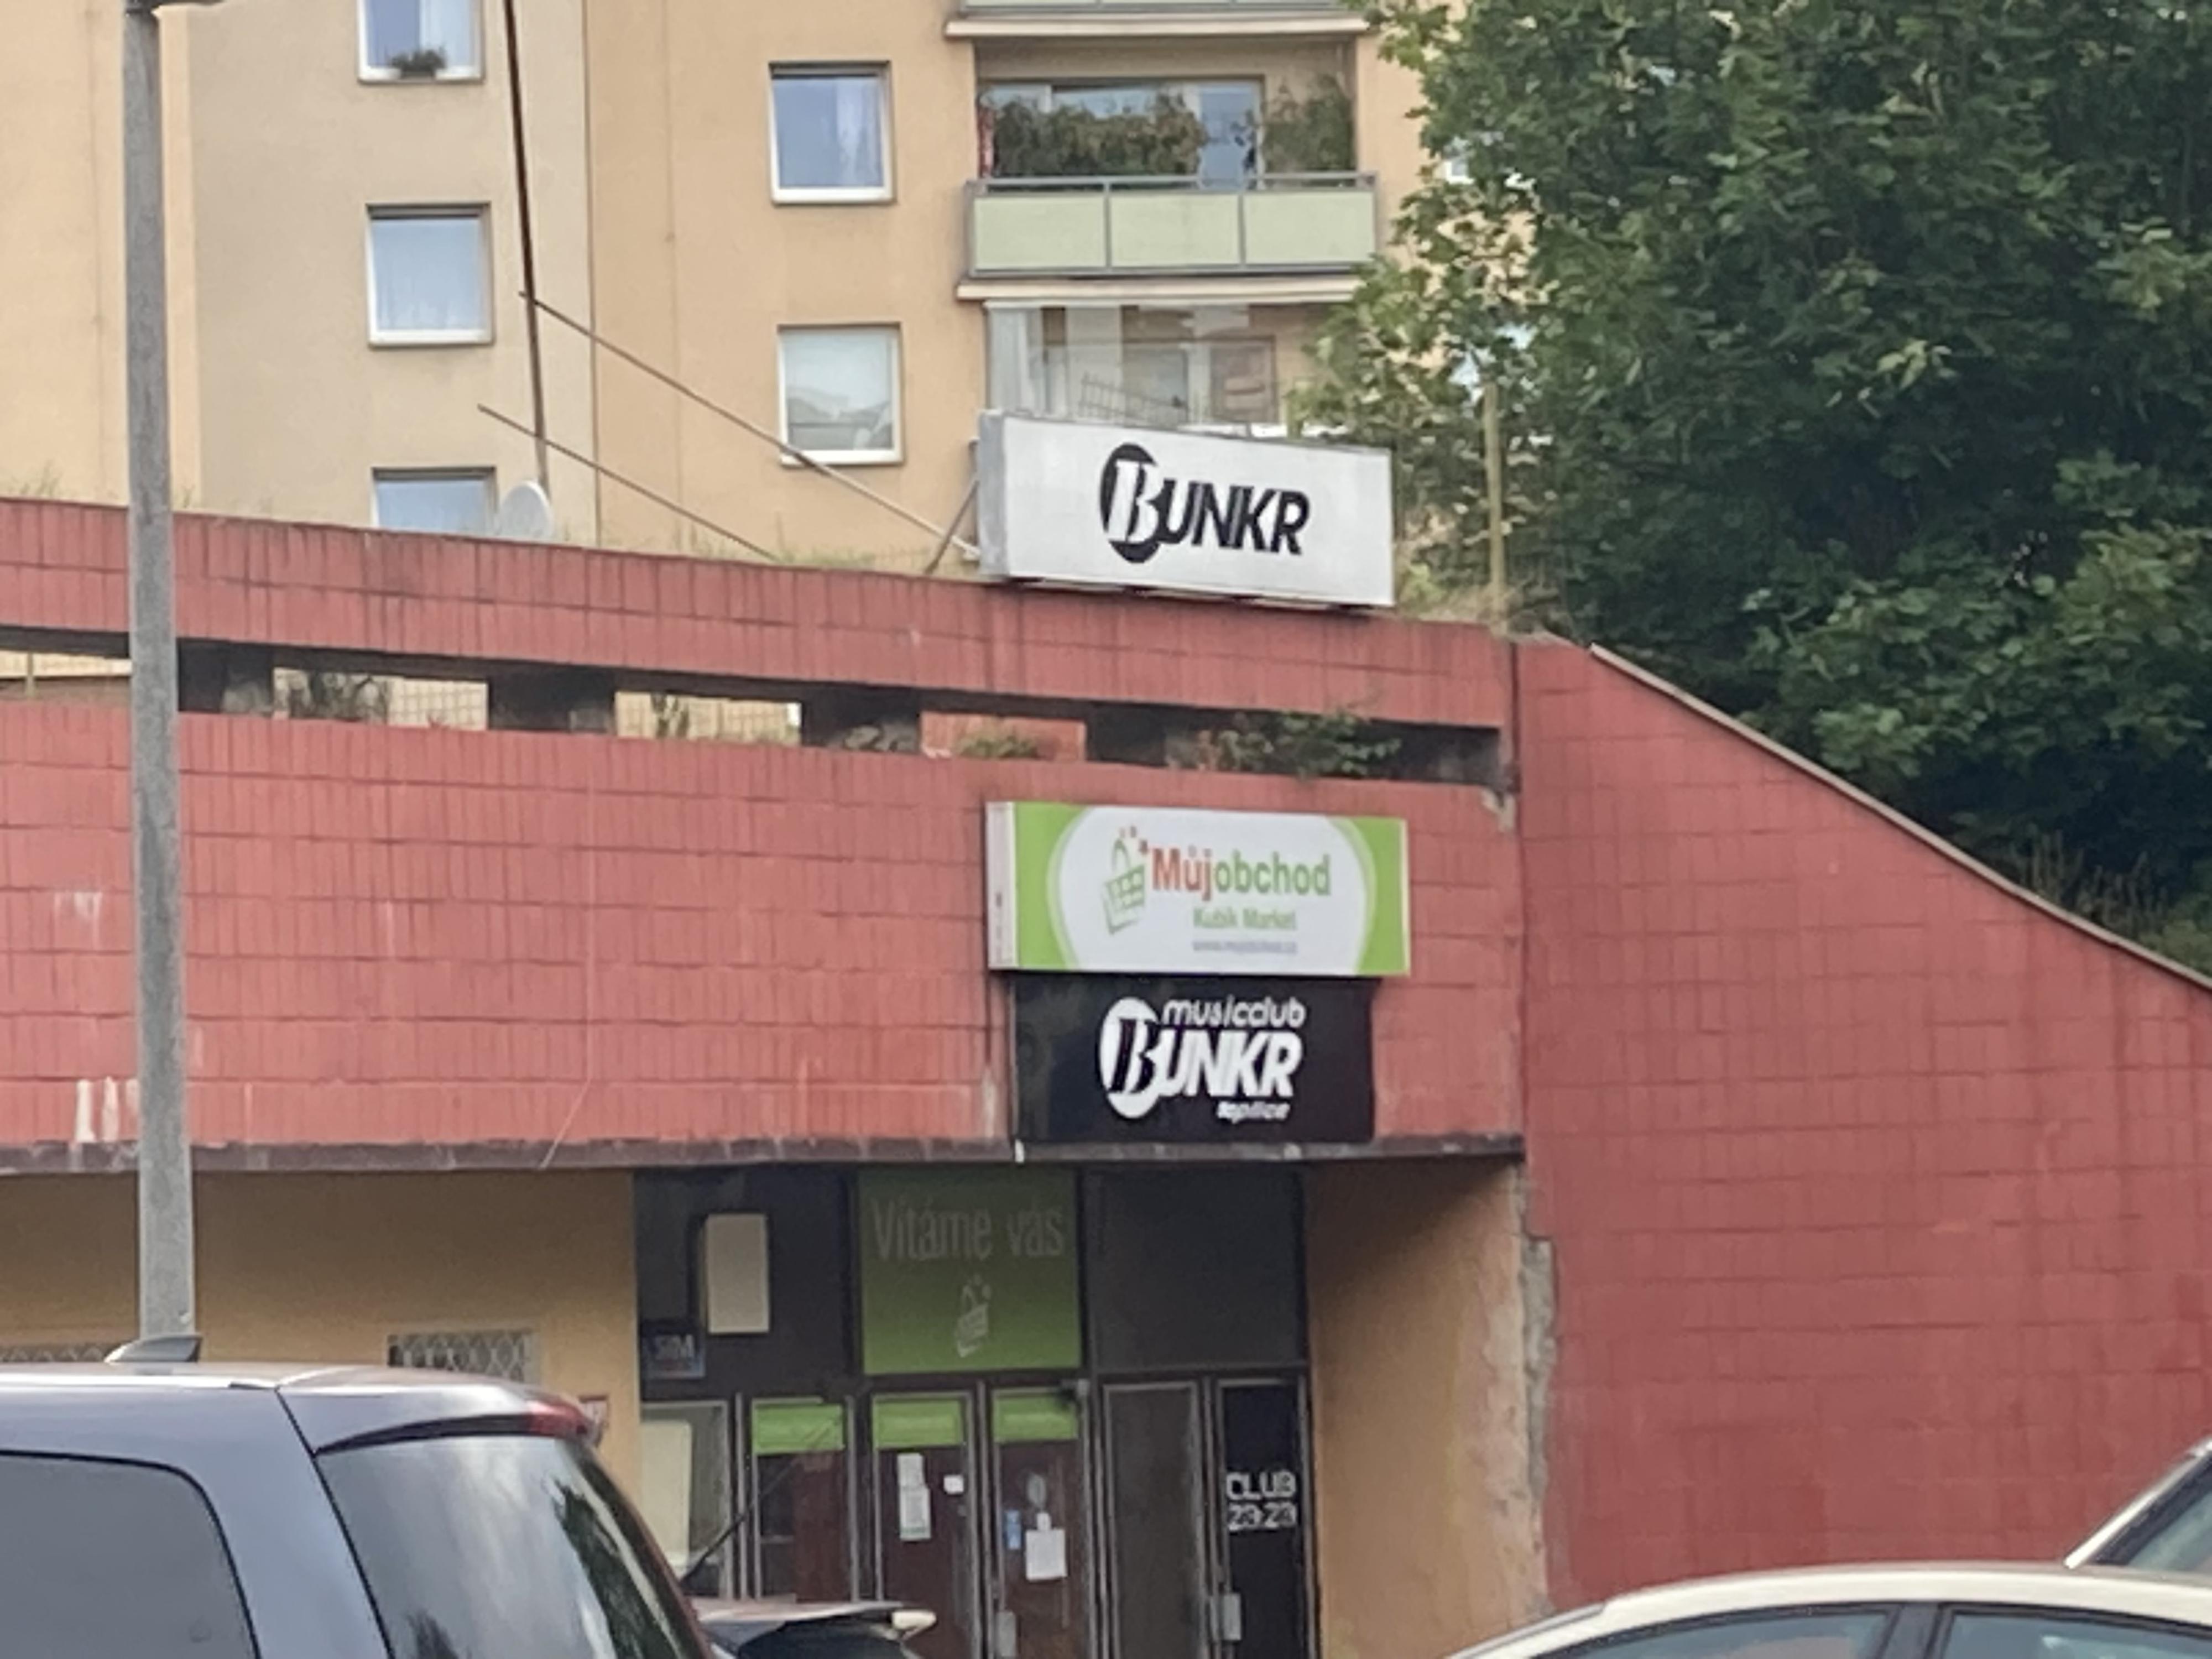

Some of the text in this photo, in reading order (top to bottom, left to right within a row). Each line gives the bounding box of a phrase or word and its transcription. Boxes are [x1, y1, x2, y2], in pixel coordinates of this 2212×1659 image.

[1099, 442, 1311, 564] BUNKR
[1099, 997, 1302, 1119] BUNKR
[1226, 1471, 1297, 1500] CLUB
